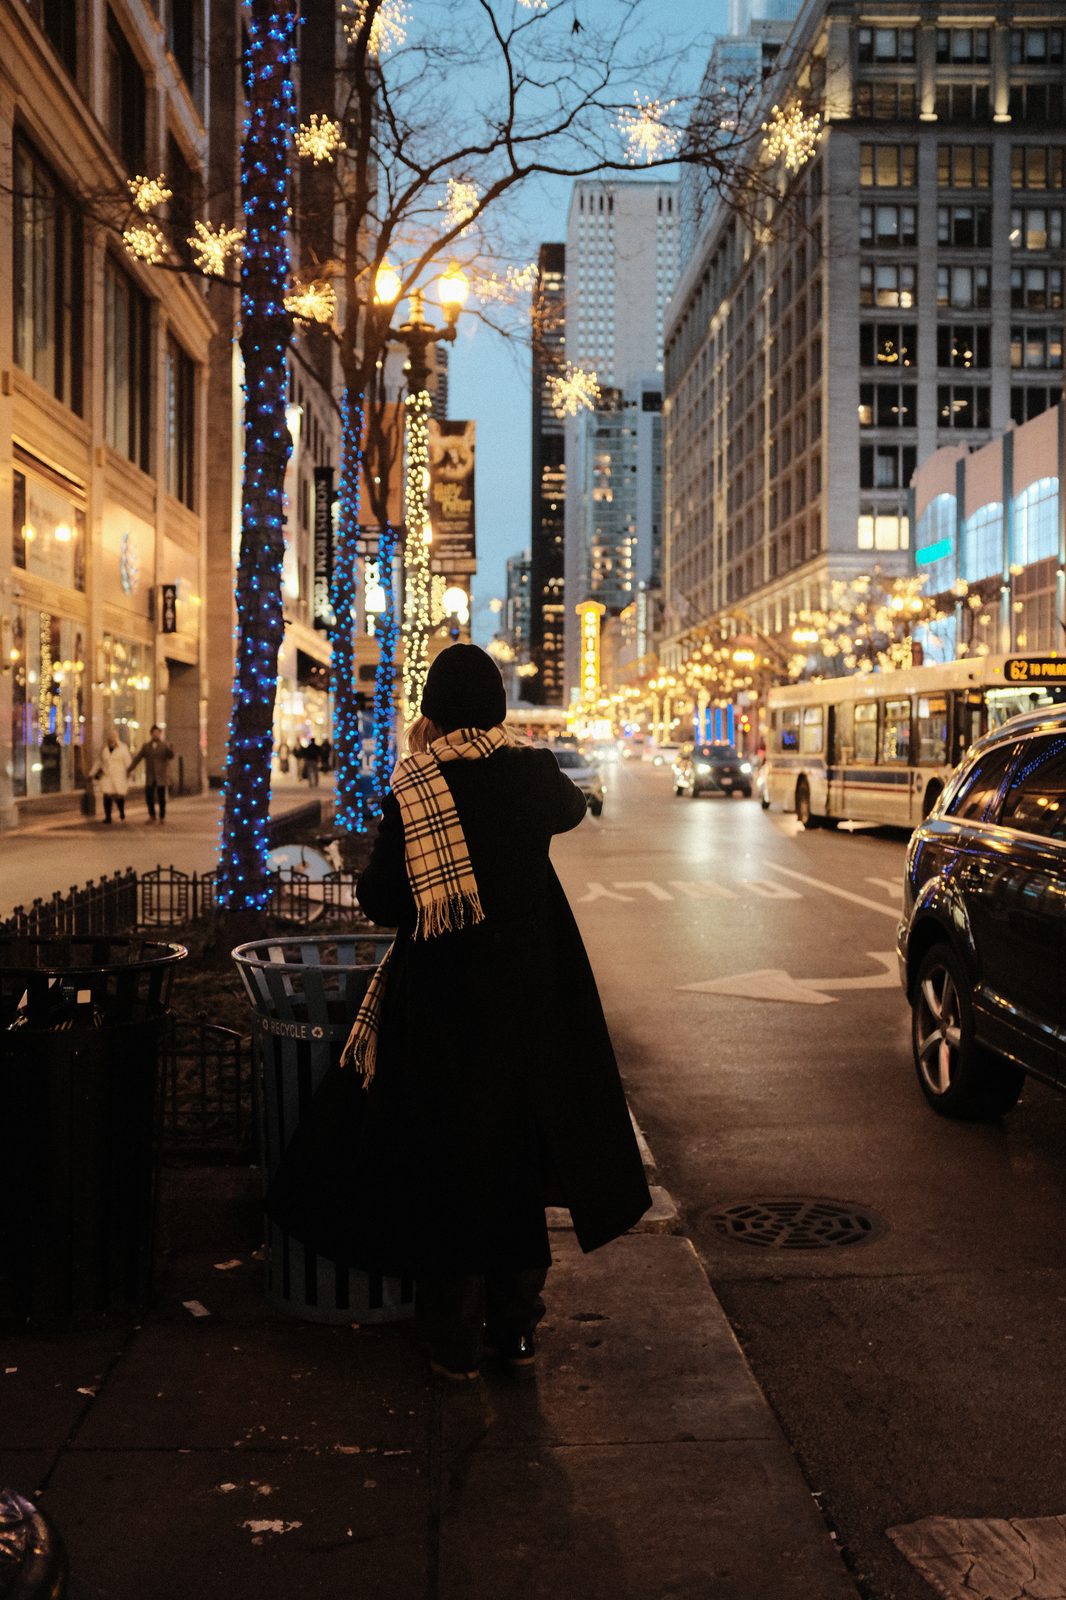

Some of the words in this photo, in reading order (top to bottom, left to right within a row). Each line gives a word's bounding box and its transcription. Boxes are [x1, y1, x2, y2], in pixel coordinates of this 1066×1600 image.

[316, 480, 327, 572] NORDSTROM
[584, 611, 597, 701] CHICAGO
[1011, 661, 1028, 680] 62
[1030, 663, 1041, 676] TO
[576, 880, 804, 901] ONLY
[271, 1021, 306, 1039] RECYCLE
